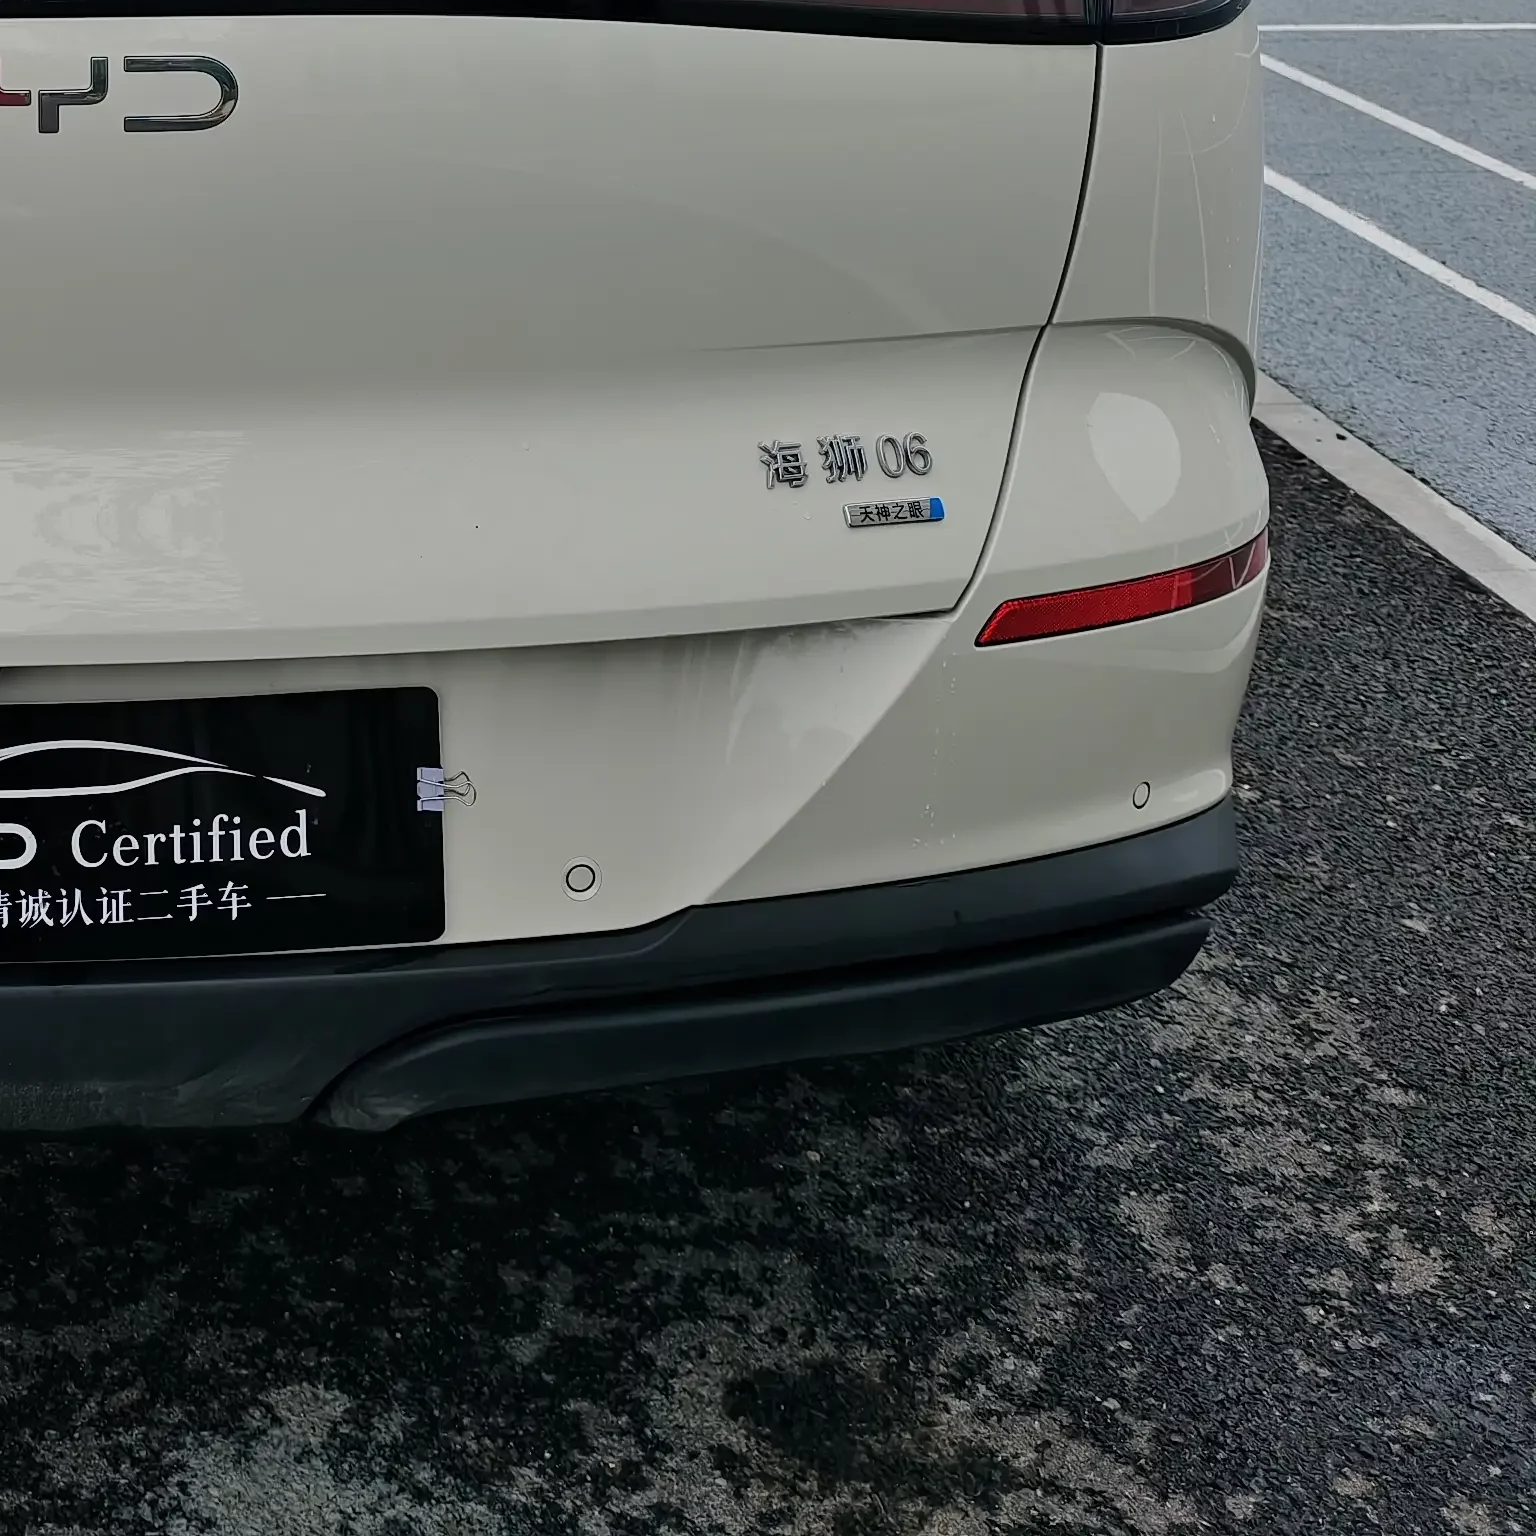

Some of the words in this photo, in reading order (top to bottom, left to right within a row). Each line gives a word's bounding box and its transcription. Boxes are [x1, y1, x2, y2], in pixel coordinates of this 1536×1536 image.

[859, 501, 925, 523] 天神之眼
[70, 808, 312, 868] Certified
